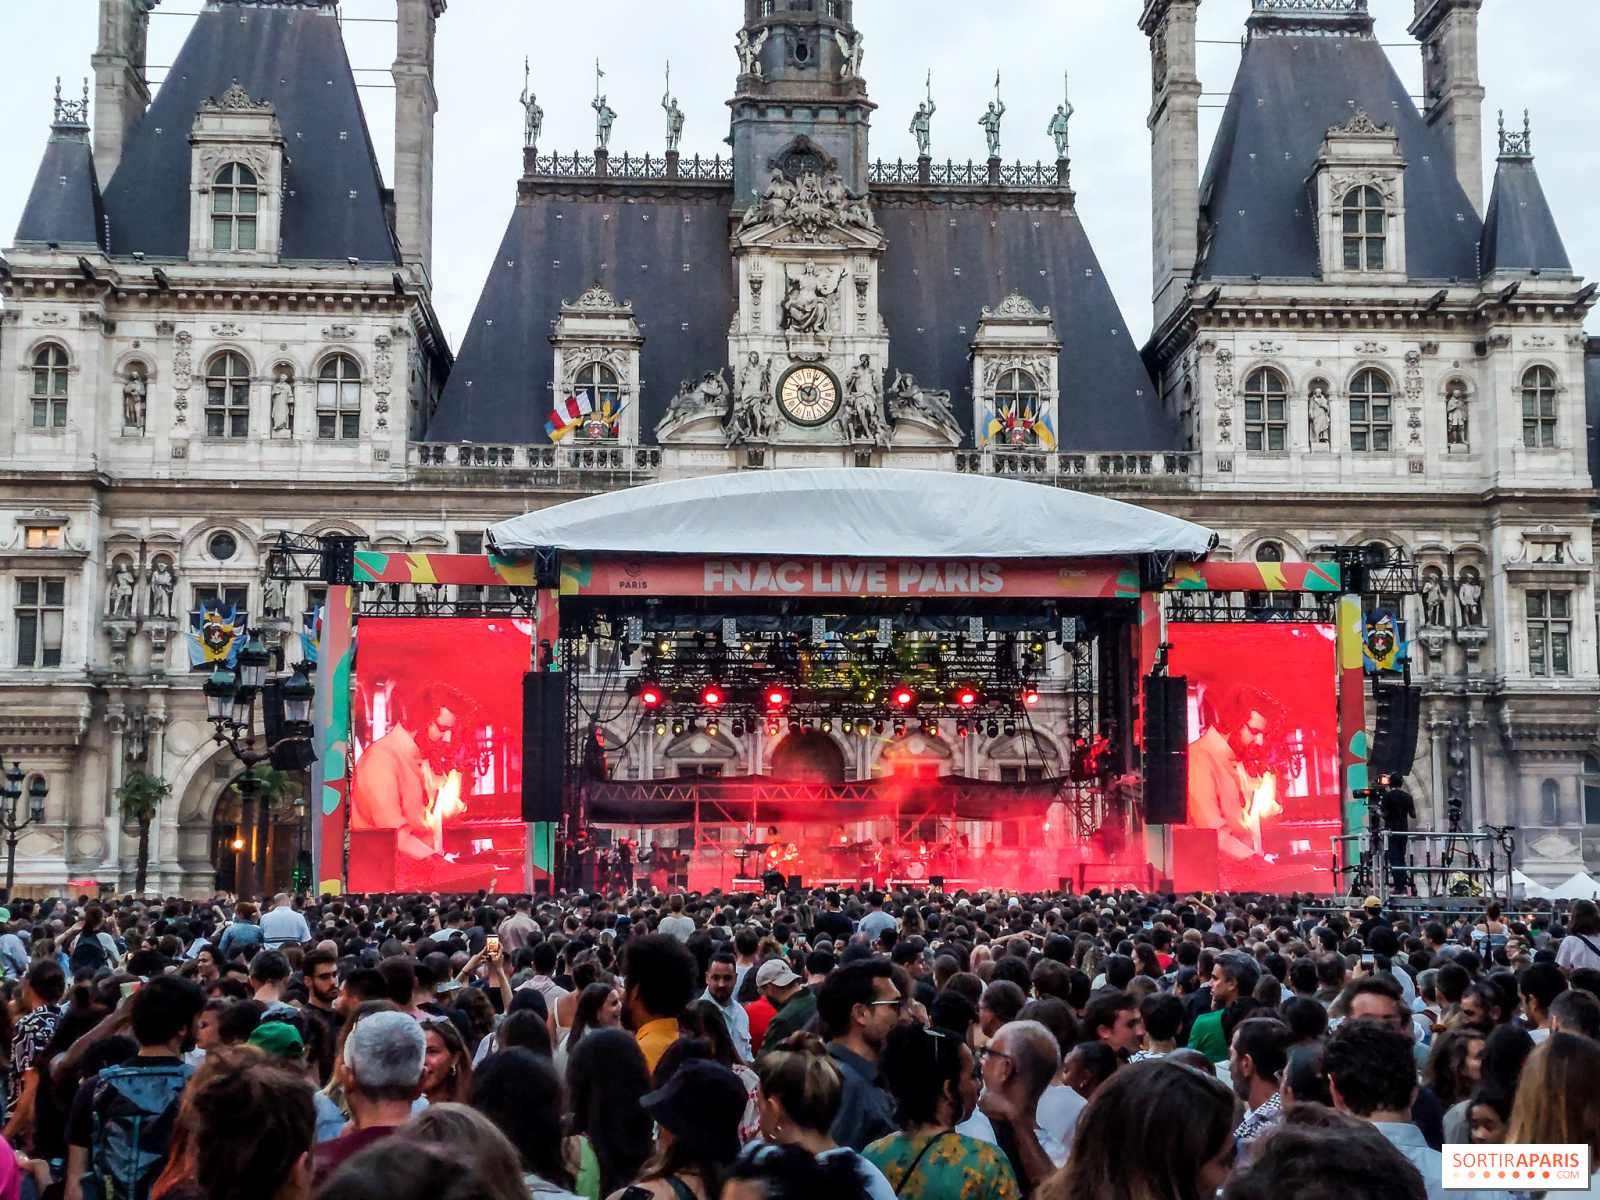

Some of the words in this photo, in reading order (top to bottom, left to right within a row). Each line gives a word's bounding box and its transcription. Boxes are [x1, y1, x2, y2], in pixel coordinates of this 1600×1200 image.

[619, 581, 648, 589] PARIS
[704, 561, 804, 592] FNAC
[812, 562, 887, 592] LIVE
[898, 562, 1004, 593] PARIS
